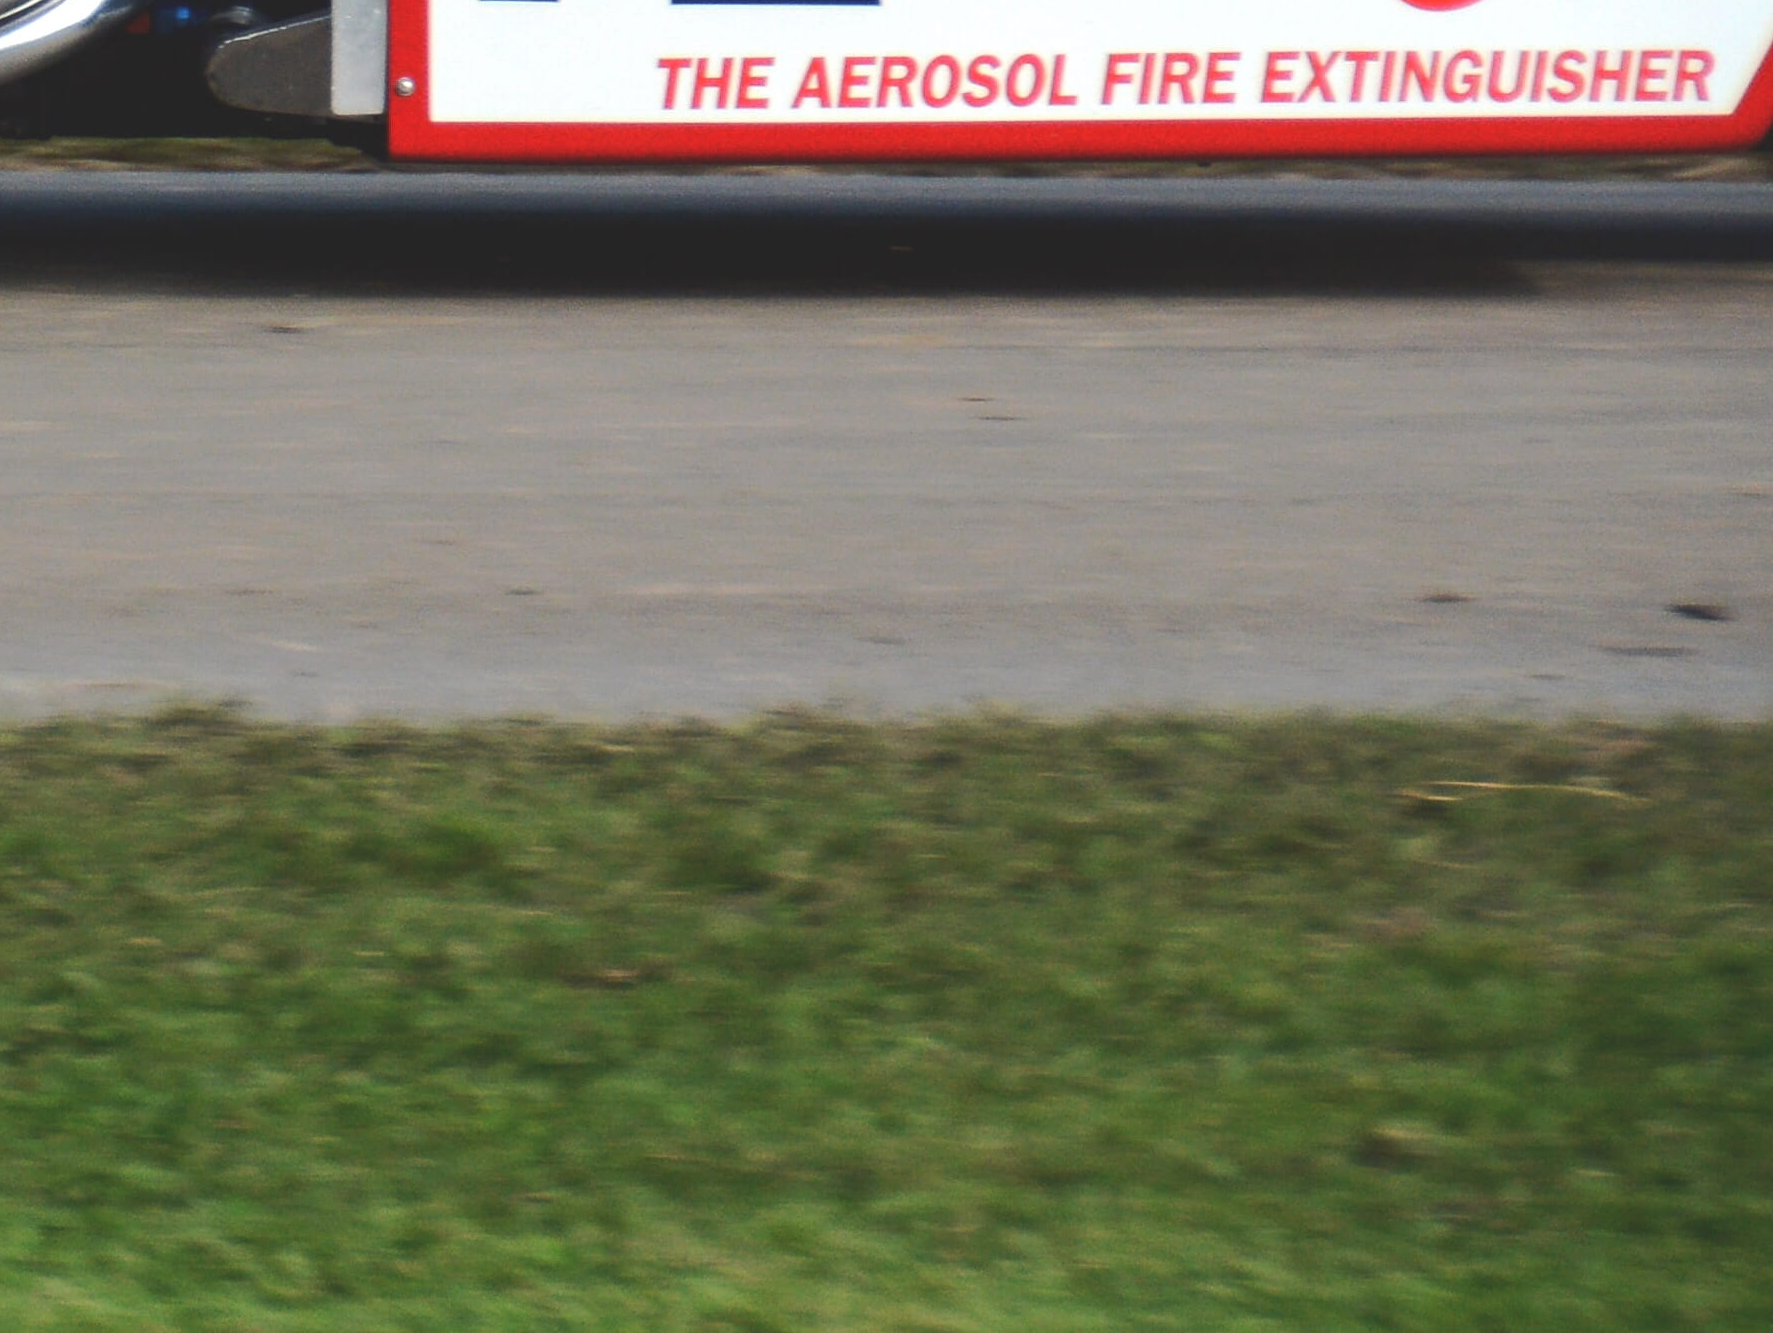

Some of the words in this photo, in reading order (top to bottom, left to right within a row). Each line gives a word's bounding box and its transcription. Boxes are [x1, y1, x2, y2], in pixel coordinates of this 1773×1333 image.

[656, 57, 776, 110] THE
[791, 54, 1078, 108] AEROSOL
[1101, 51, 1243, 105] FIRE
[1260, 49, 1717, 104] EXTINGUISHER
